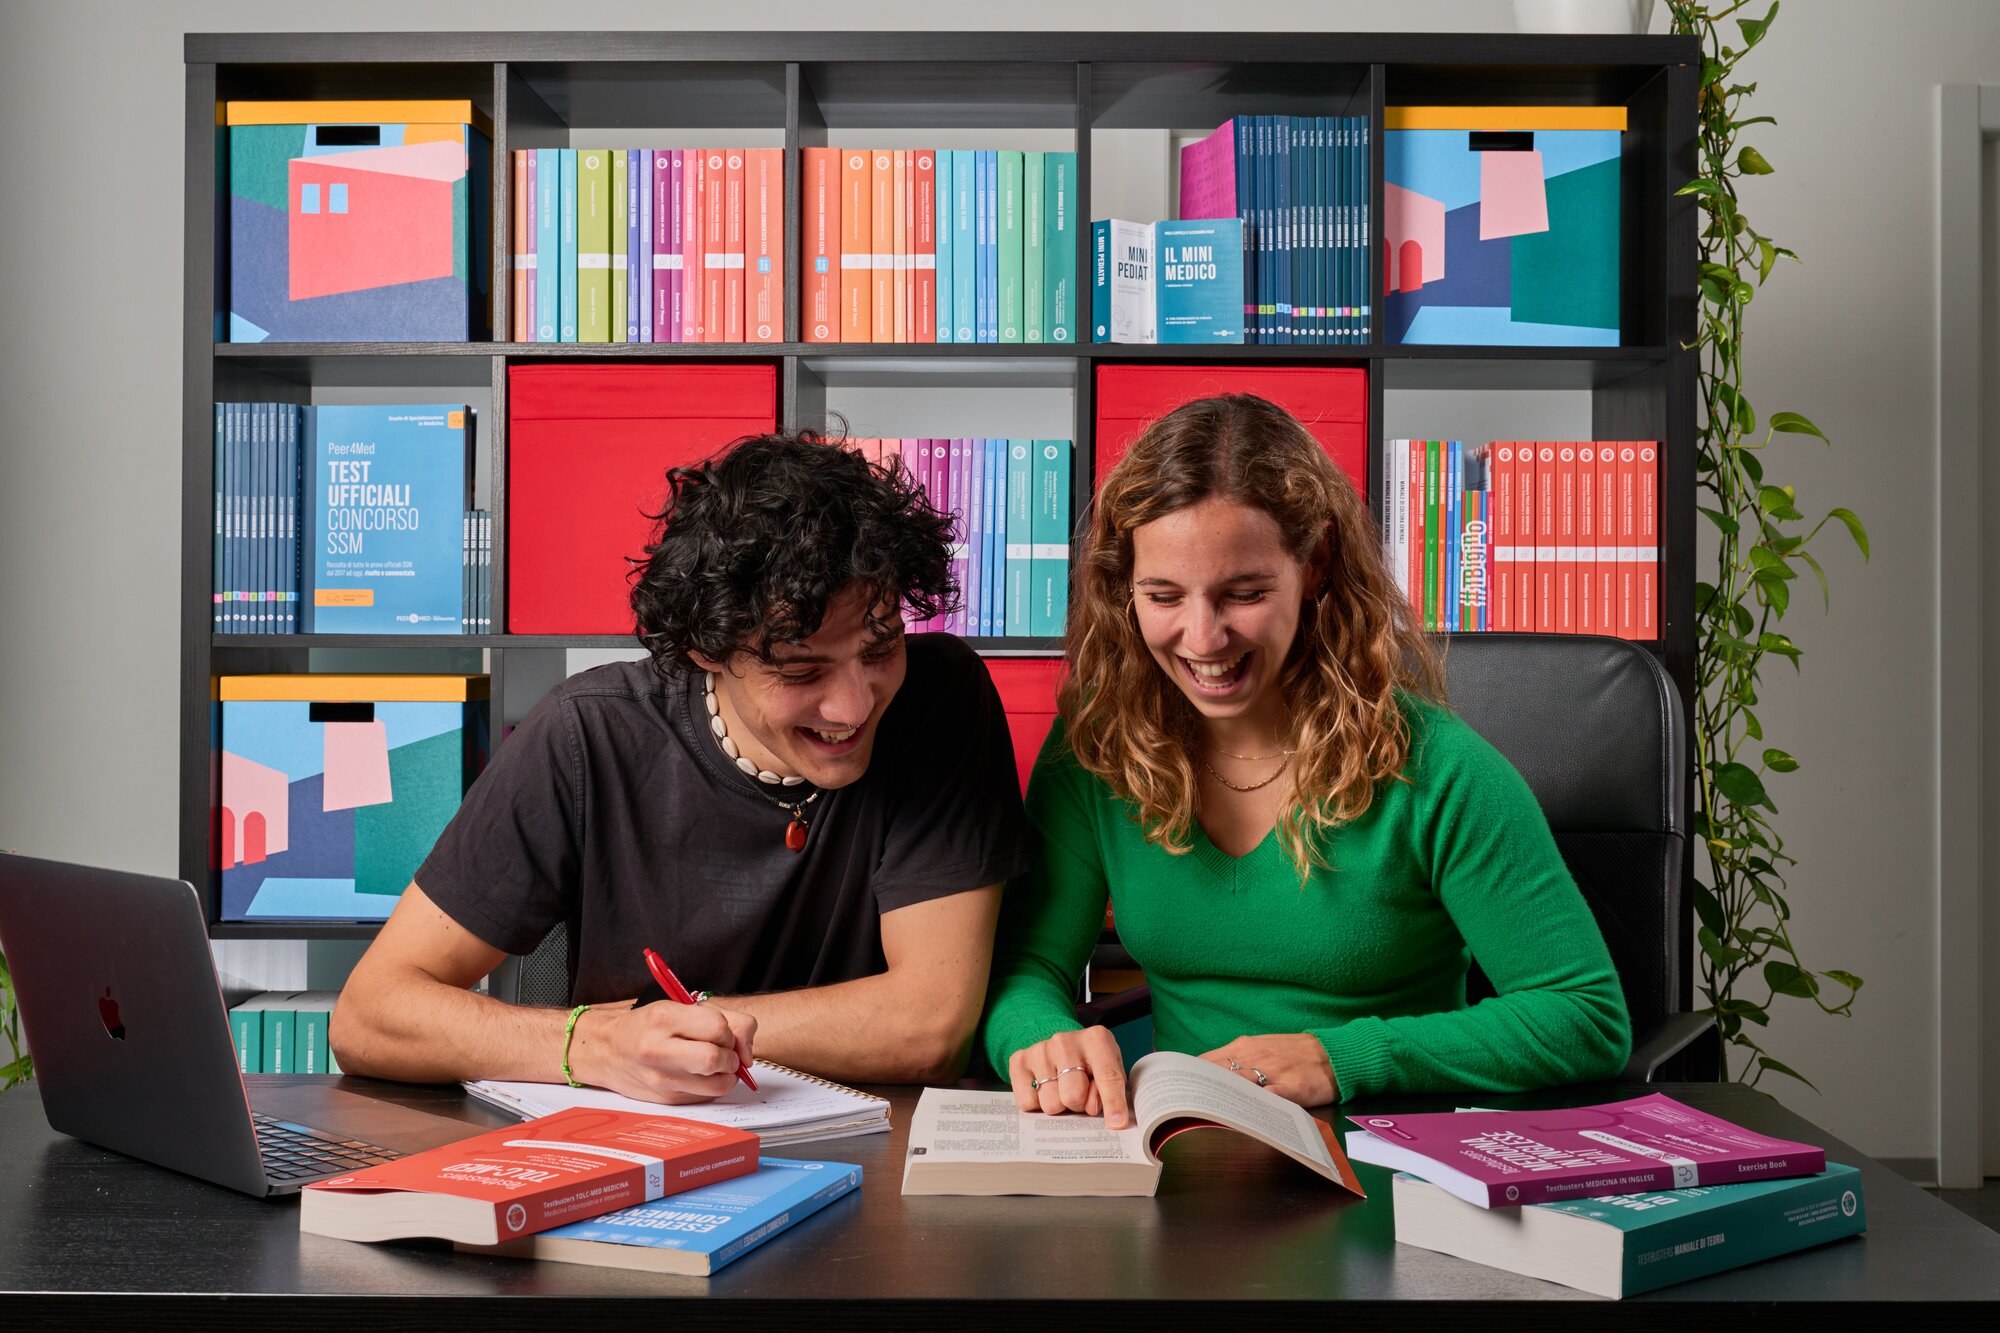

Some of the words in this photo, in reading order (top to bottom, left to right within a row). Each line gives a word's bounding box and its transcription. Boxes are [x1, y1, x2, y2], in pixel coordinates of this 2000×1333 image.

[1128, 246, 1148, 264] MINI
[1165, 247, 1178, 263] IL
[1182, 246, 1212, 262] MINI
[1165, 264, 1216, 280] MEDICO
[328, 442, 375, 455] Peer4Med
[328, 461, 371, 483] TEST
[328, 484, 410, 506] UFFICIALI
[327, 508, 419, 530] CONCORSO
[327, 532, 363, 554] SSM
[1460, 1137, 1563, 1171] MEDICINA
[1481, 1131, 1574, 1160] INGLESE
[442, 1163, 560, 1183] TOLC-MED
[679, 1164, 710, 1179] Eserciziario
[711, 1155, 746, 1171] commentato
[1556, 1158, 1598, 1168] IN
[1738, 1162, 1768, 1173] Exercise
[1769, 1160, 1788, 1169] Book
[438, 1173, 528, 1190] Testbusters
[1546, 1182, 1585, 1193] Testbusters
[1585, 1178, 1618, 1189] MEDICINA
[1628, 1174, 1655, 1184] INGLESE
[543, 1194, 575, 1209] Testbusters
[576, 1187, 602, 1202] TOLC-MED
[602, 1181, 629, 1196] MEDICINA
[544, 1206, 567, 1218] Medicina
[1638, 1246, 1674, 1266] TESTBUSTERS
[1675, 1238, 1700, 1256] MANUALE
[1700, 1238, 1706, 1248] DI
[1707, 1232, 1725, 1248] TEORIA
